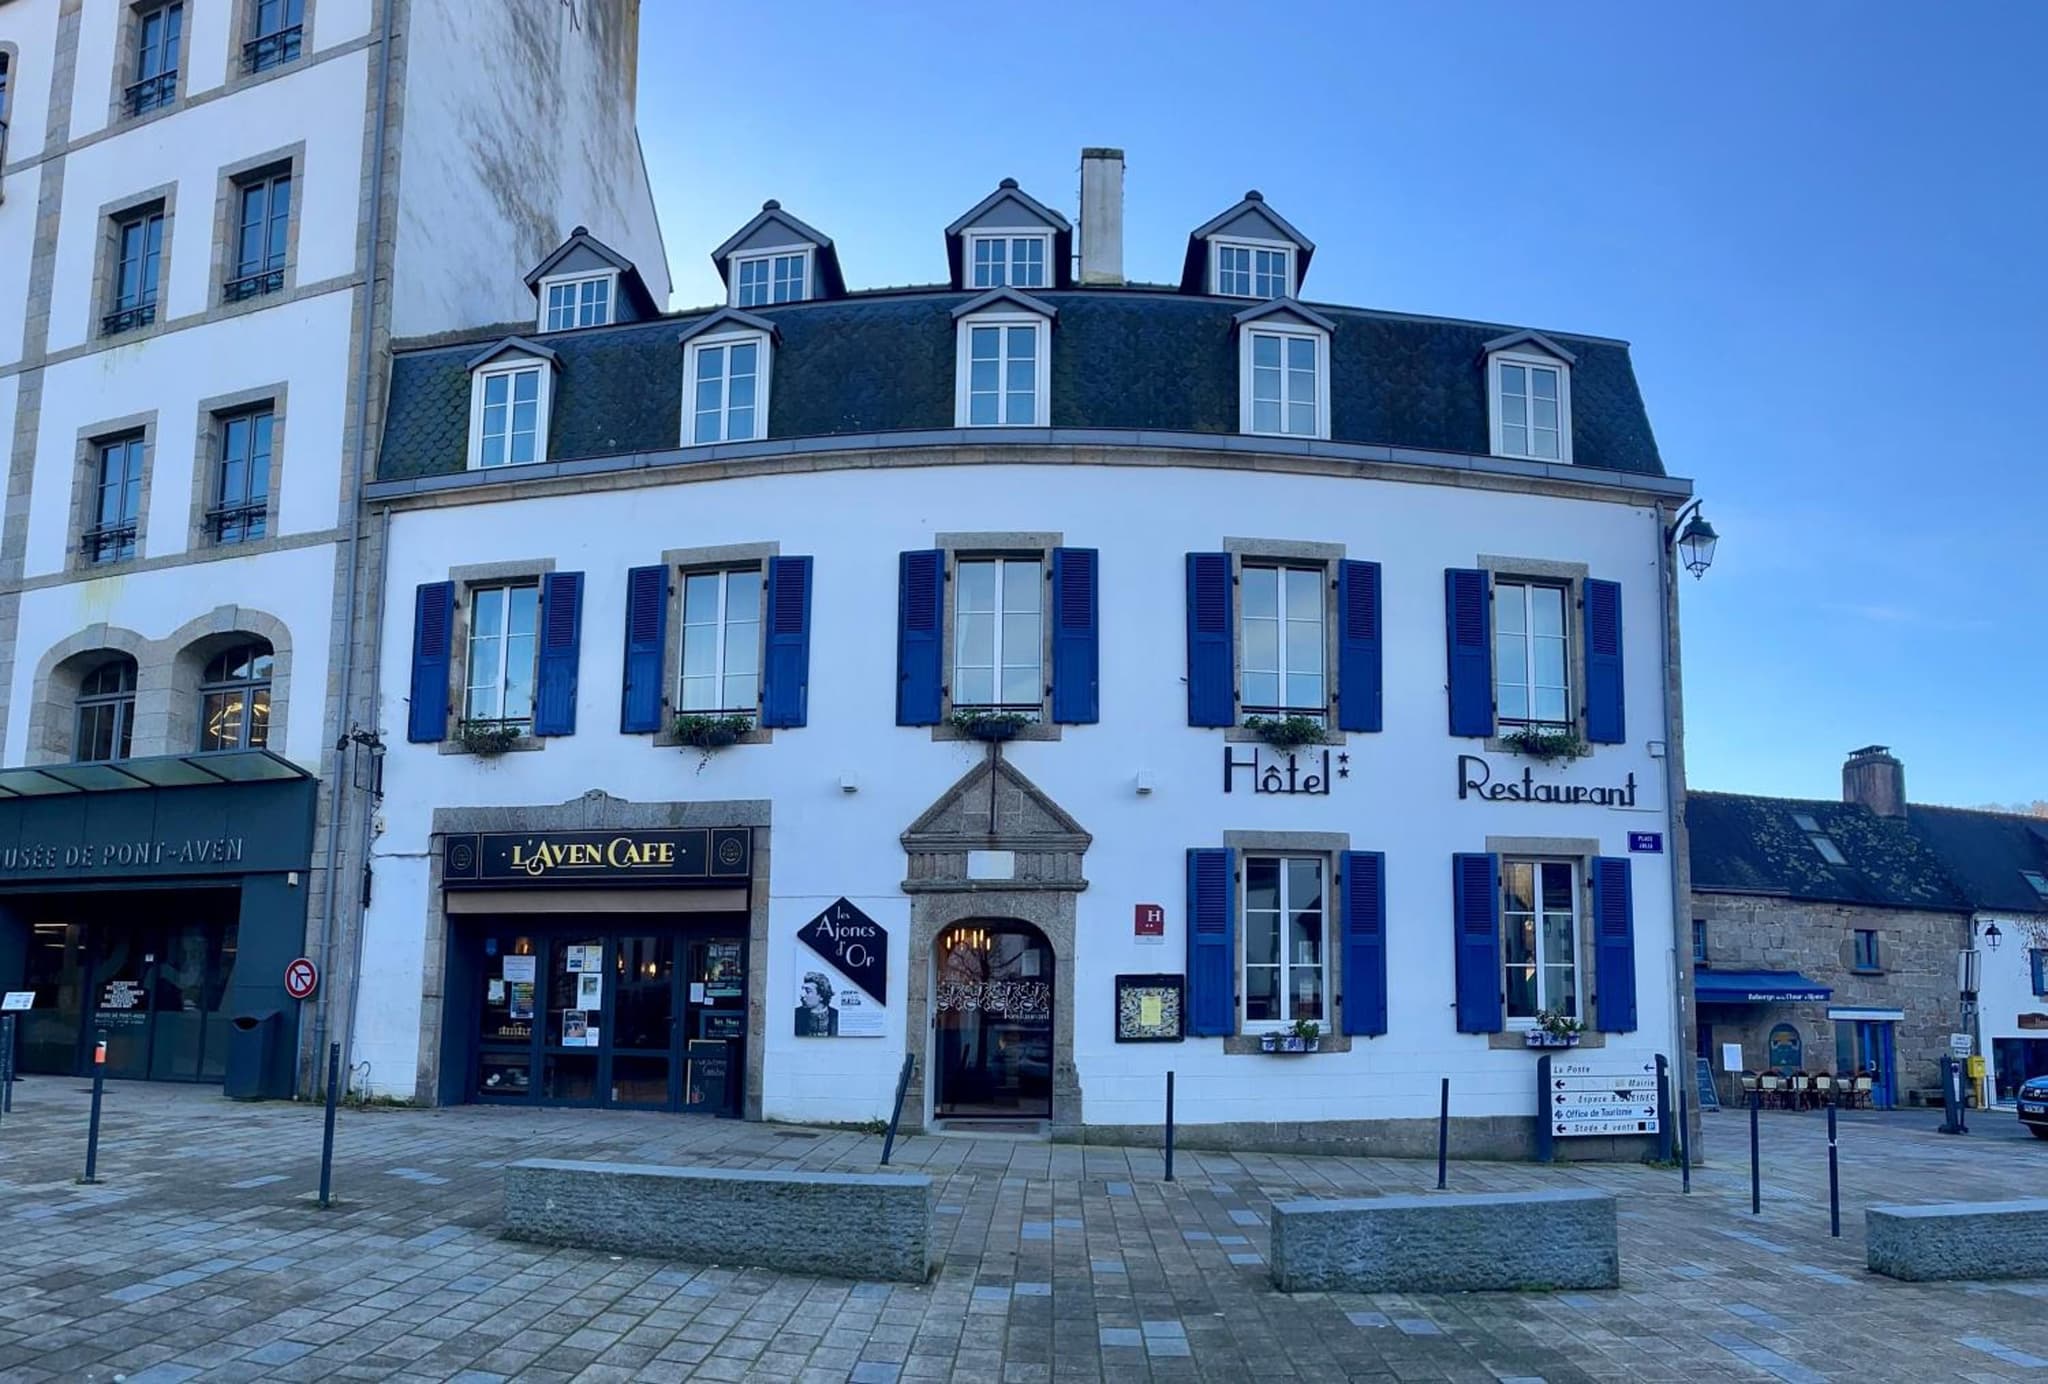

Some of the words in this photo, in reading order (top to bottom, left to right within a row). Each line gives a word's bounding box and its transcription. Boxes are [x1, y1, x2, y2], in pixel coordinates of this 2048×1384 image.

[1224, 746, 1330, 795] Hôtel
[1458, 754, 1637, 807] Restaurant
[0, 844, 57, 869] USÉE
[65, 845, 94, 867] DE
[102, 837, 243, 866] PONT-AVEN
[511, 839, 603, 876] L'AVEN
[607, 837, 675, 868] CAFE
[837, 905, 851, 920] les
[815, 914, 876, 942] Ajoncs
[835, 940, 875, 968] d'Or
[1566, 1065, 1591, 1073] Poste
[1565, 1108, 1588, 1118] Office
[1590, 1109, 1599, 1117] de
[1601, 1107, 1633, 1116] Tourisme
[1574, 1124, 1598, 1132] Stade
[1602, 1123, 1608, 1131] 4
